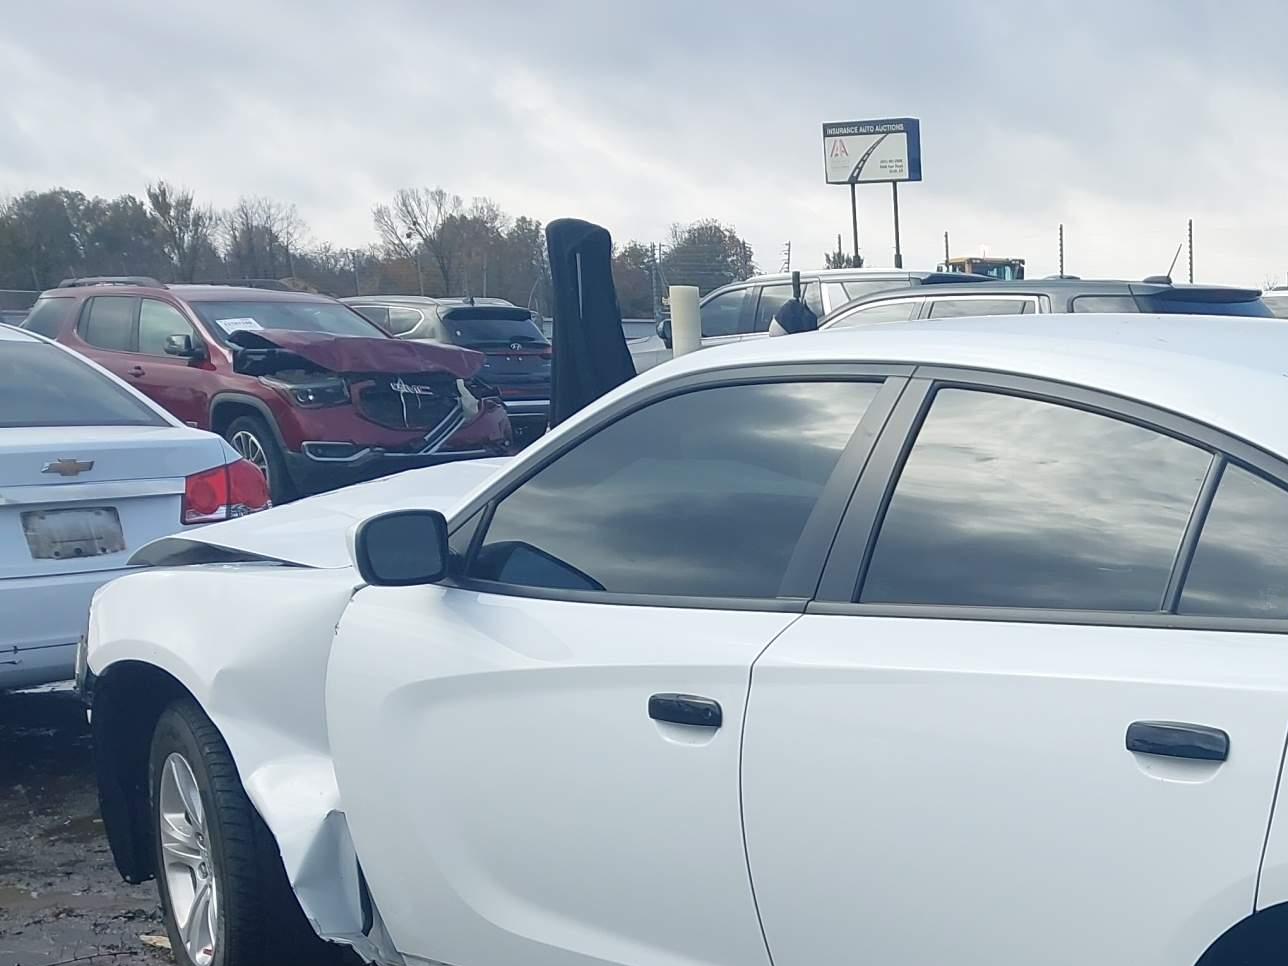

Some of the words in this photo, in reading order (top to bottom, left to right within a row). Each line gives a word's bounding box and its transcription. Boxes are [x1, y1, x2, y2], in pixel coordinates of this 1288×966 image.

[826, 126, 858, 135] INSURANCE
[859, 125, 875, 133] AUTO
[875, 123, 905, 132] AUCTIONS
